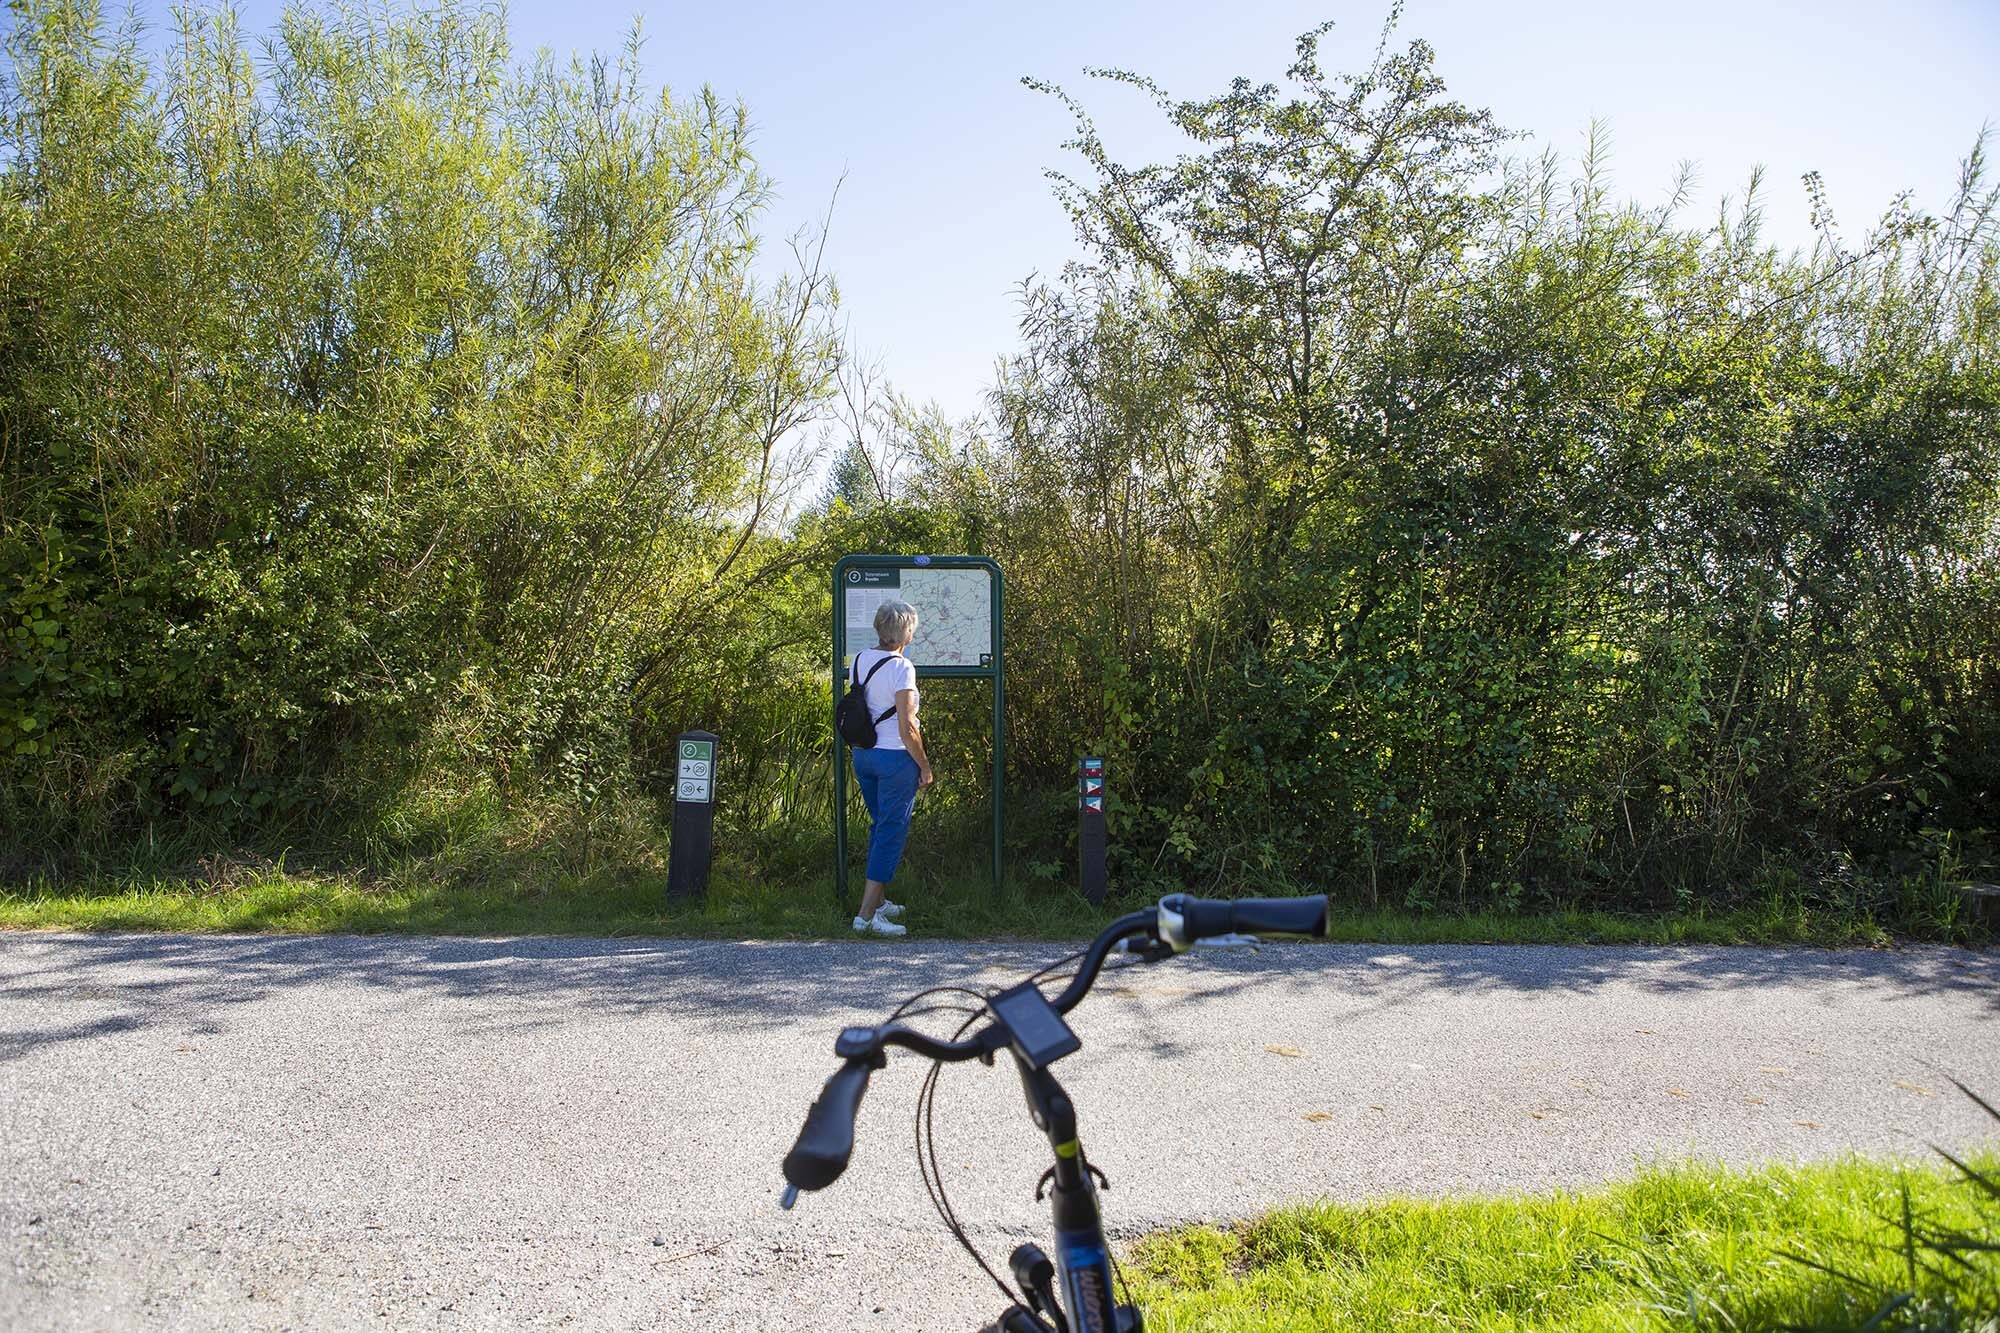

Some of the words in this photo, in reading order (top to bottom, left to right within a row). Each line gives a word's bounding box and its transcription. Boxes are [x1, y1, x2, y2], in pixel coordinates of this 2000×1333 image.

[686, 746, 693, 755] 2
[695, 765, 705, 773] 29
[683, 785, 693, 793] 39
